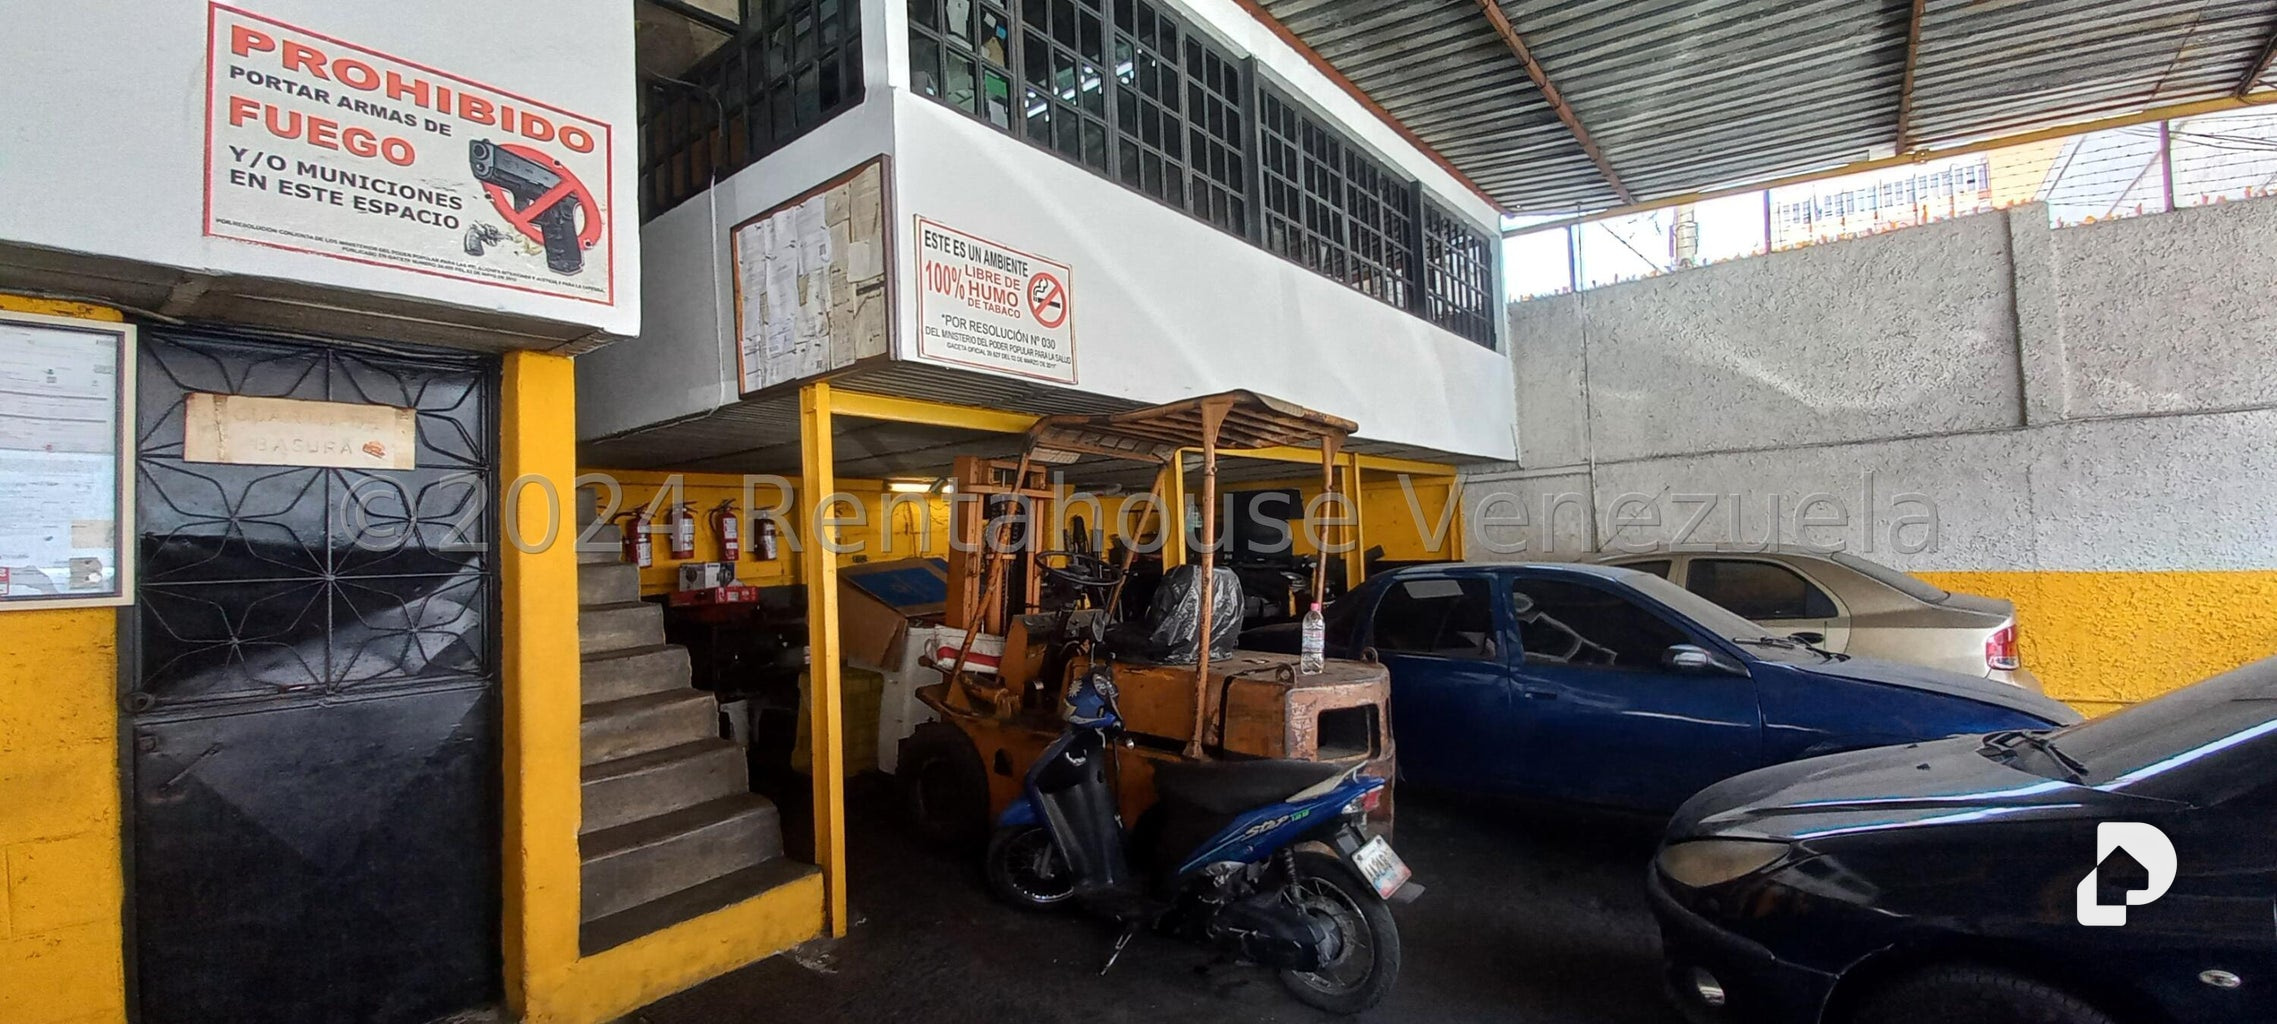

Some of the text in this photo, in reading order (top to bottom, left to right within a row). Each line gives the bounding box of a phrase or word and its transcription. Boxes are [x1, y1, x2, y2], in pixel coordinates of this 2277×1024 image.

[230, 65, 452, 136] PORTAR ARMAS DE
[231, 24, 595, 153] PROHIBIDO
[229, 95, 416, 166] FUEGO
[229, 145, 463, 210] Y/O MUNICIONES
[230, 169, 460, 230] EN ESTE ESPACIO
[924, 229, 1029, 278] ESTE ES UN AMBIENTE
[925, 259, 1021, 300] 100% LIBRE DE
[968, 280, 1019, 307] HUMO
[967, 297, 1021, 319] DE TABACO
[925, 325, 1072, 365] DEL MINISTERIO DEL PODER POPULAR PARA LA SALUD
[969, 320, 1029, 344] RESOLUCIÓN
[1041, 338, 1056, 350] 030
